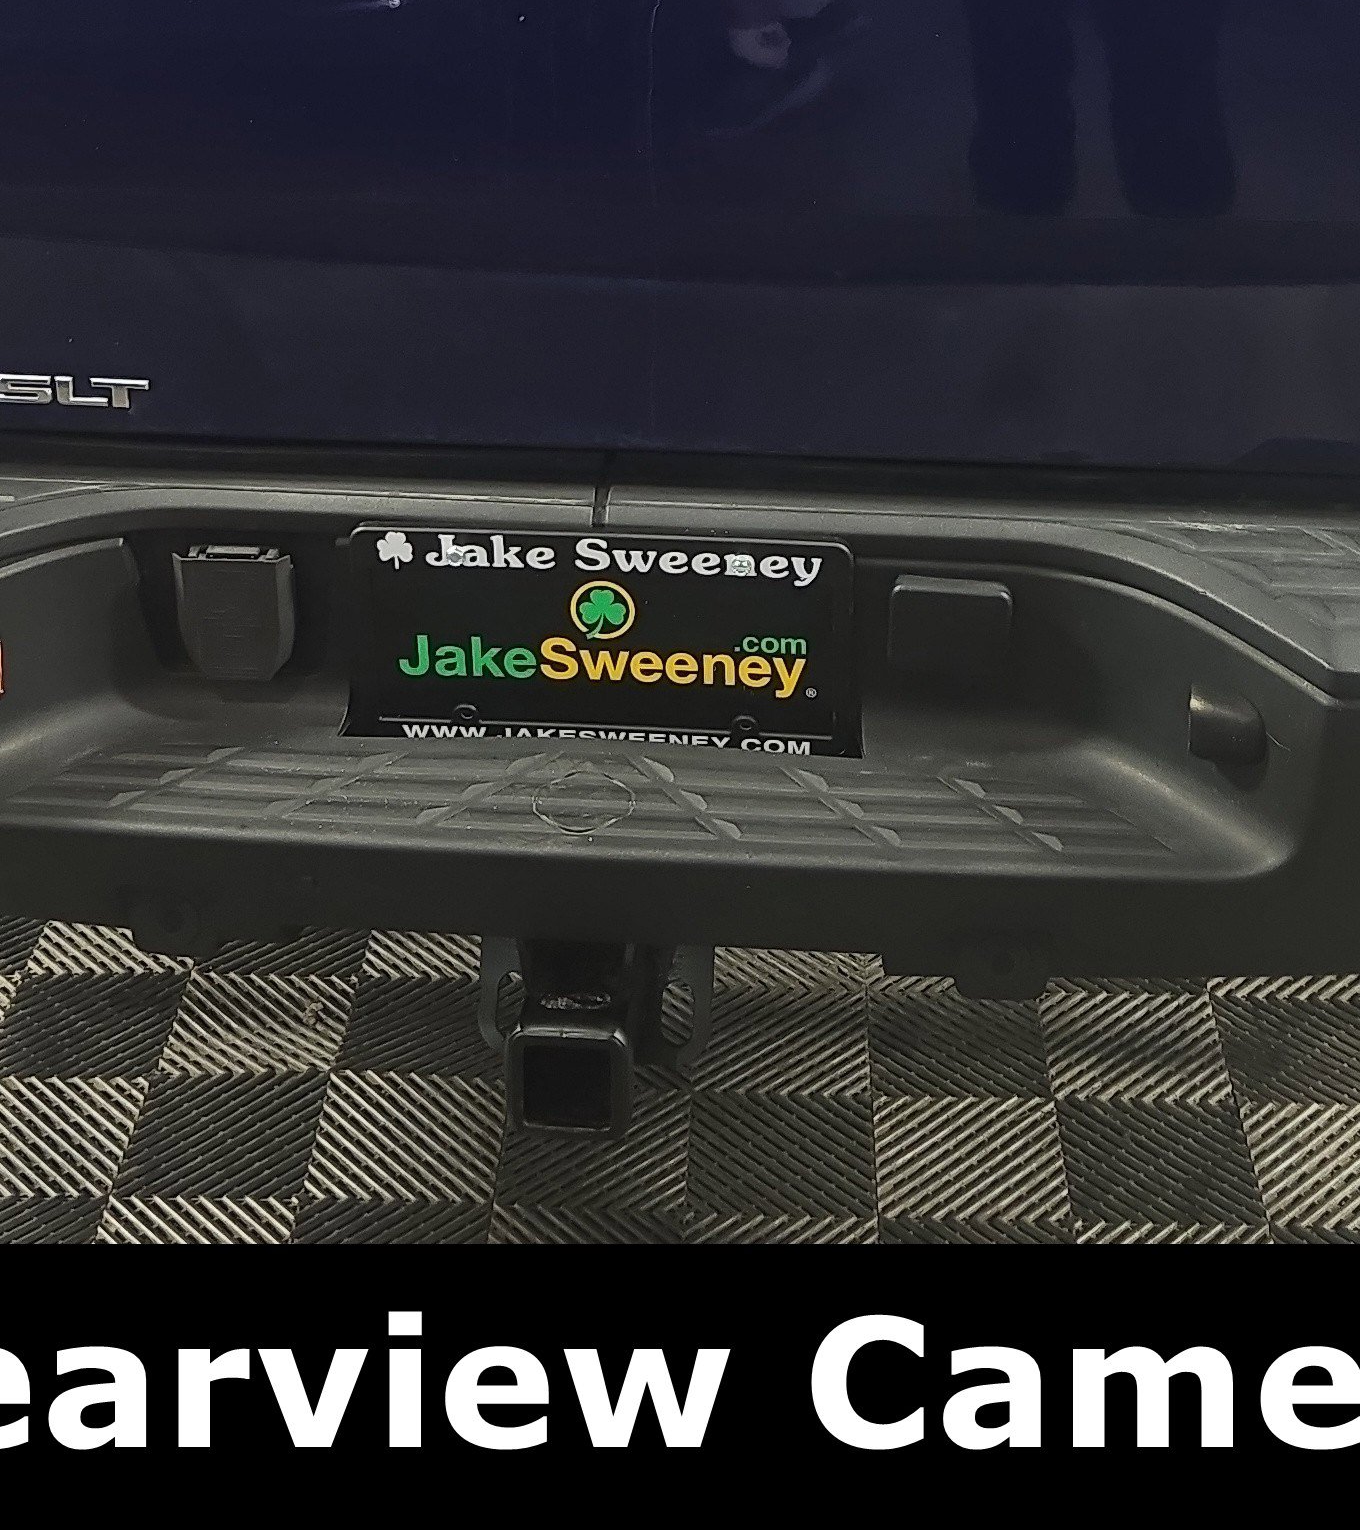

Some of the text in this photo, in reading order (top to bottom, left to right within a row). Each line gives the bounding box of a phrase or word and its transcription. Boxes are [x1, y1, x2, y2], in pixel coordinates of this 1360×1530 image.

[426, 534, 824, 587] Jake Sweeney
[733, 635, 808, 656] .com
[401, 724, 811, 756] WWWJAKESWEENEYCOM
